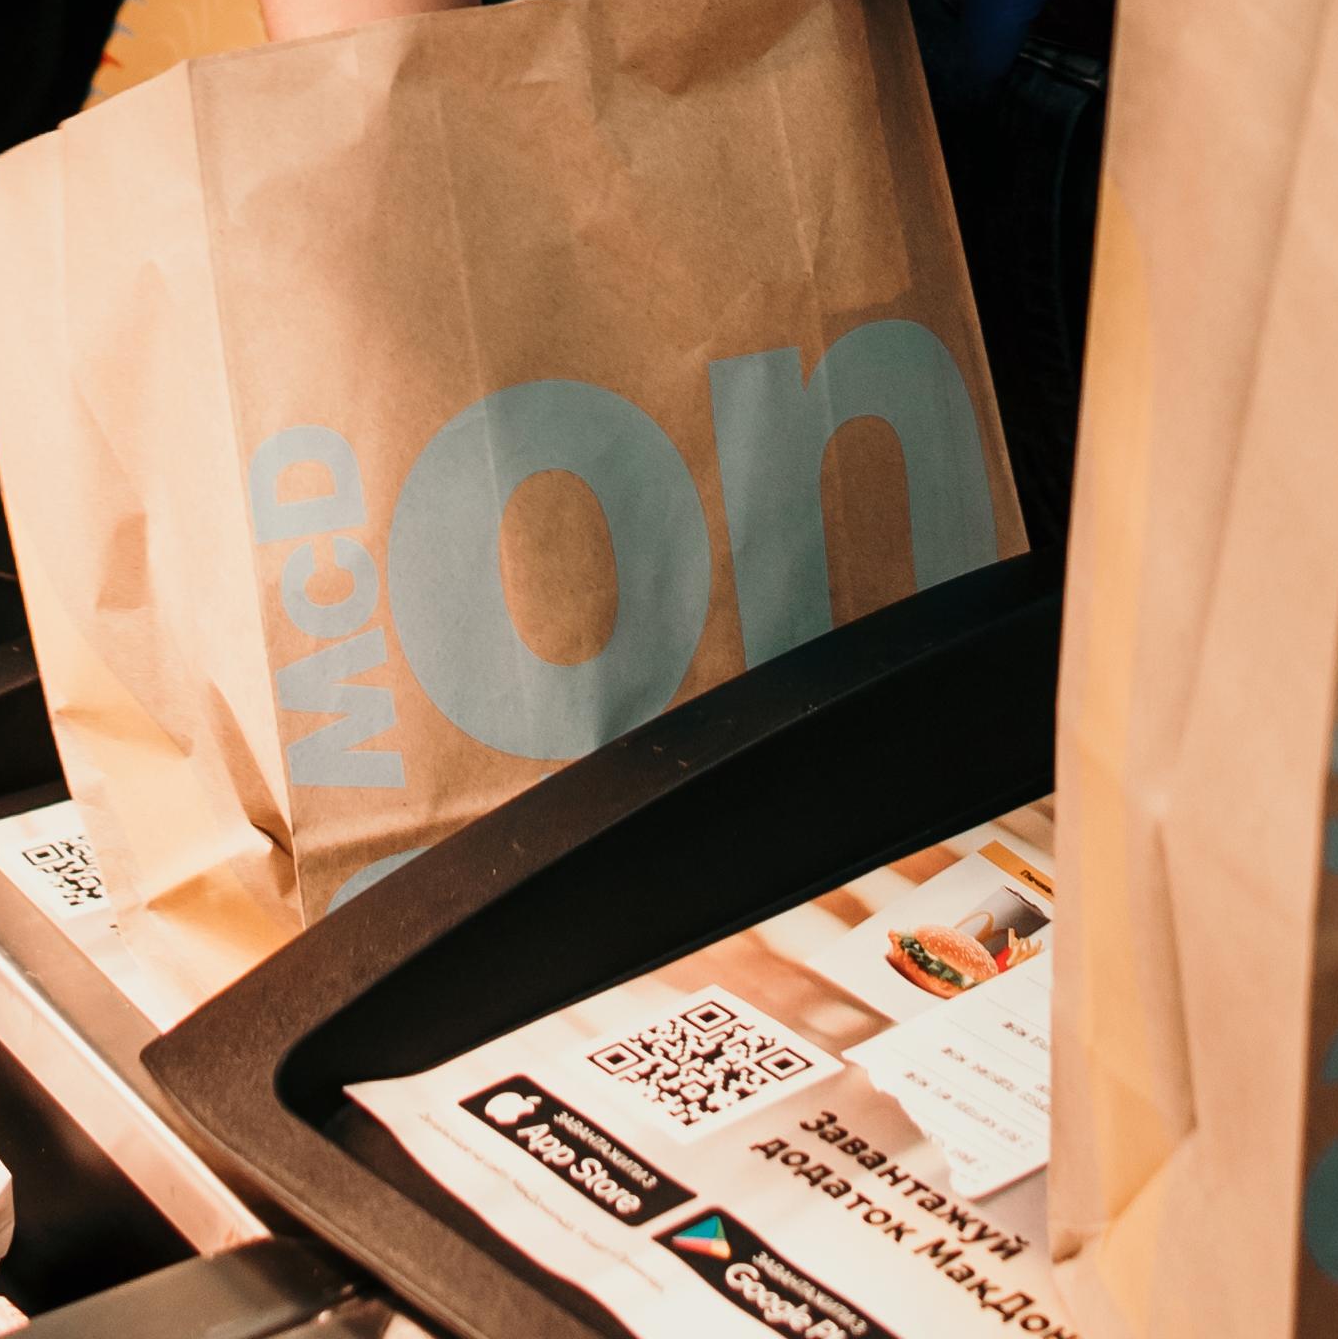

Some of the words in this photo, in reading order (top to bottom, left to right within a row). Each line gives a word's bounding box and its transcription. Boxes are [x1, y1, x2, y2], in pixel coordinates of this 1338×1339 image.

[517, 1123, 575, 1167] App
[570, 1158, 642, 1215] Store
[750, 1137, 914, 1243] додаток
[800, 1110, 1029, 1261] Завантажуй
[725, 1263, 812, 1332] Google
